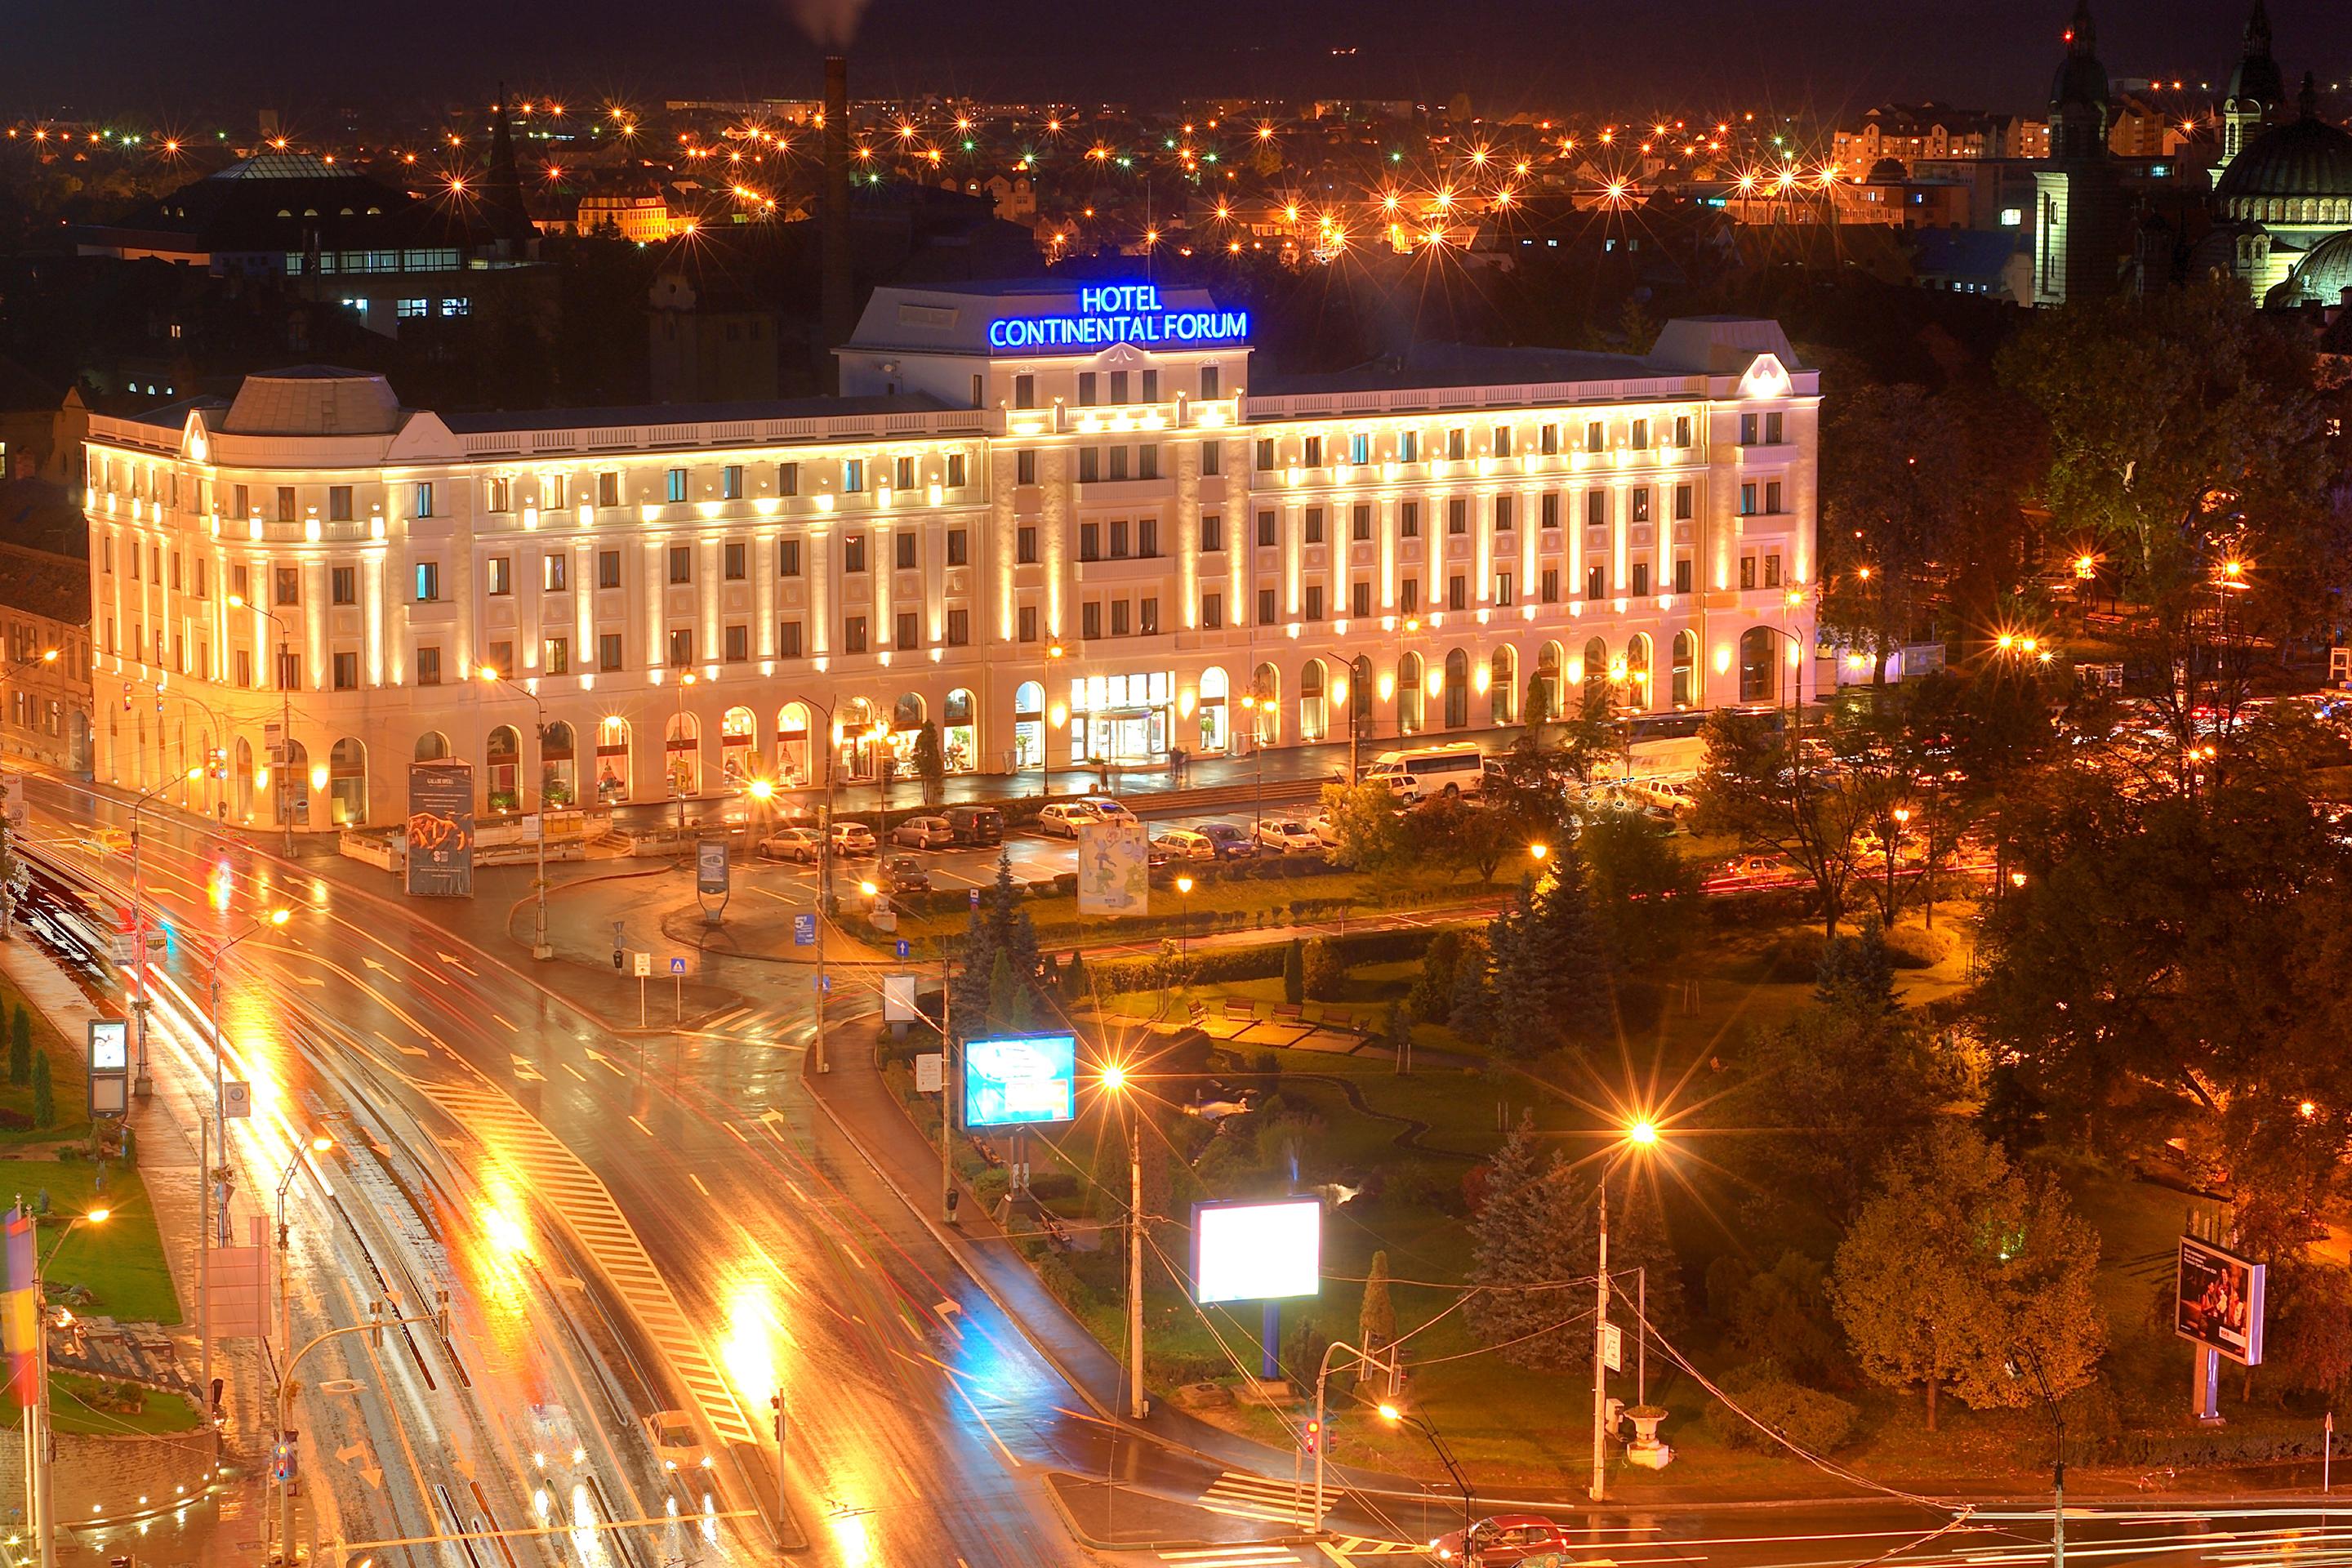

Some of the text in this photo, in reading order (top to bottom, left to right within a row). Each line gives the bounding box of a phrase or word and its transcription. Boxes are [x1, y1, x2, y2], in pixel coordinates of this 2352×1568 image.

[1082, 285, 1162, 313] HOTEL
[989, 312, 1247, 346] CONTINENTAL FORUM
